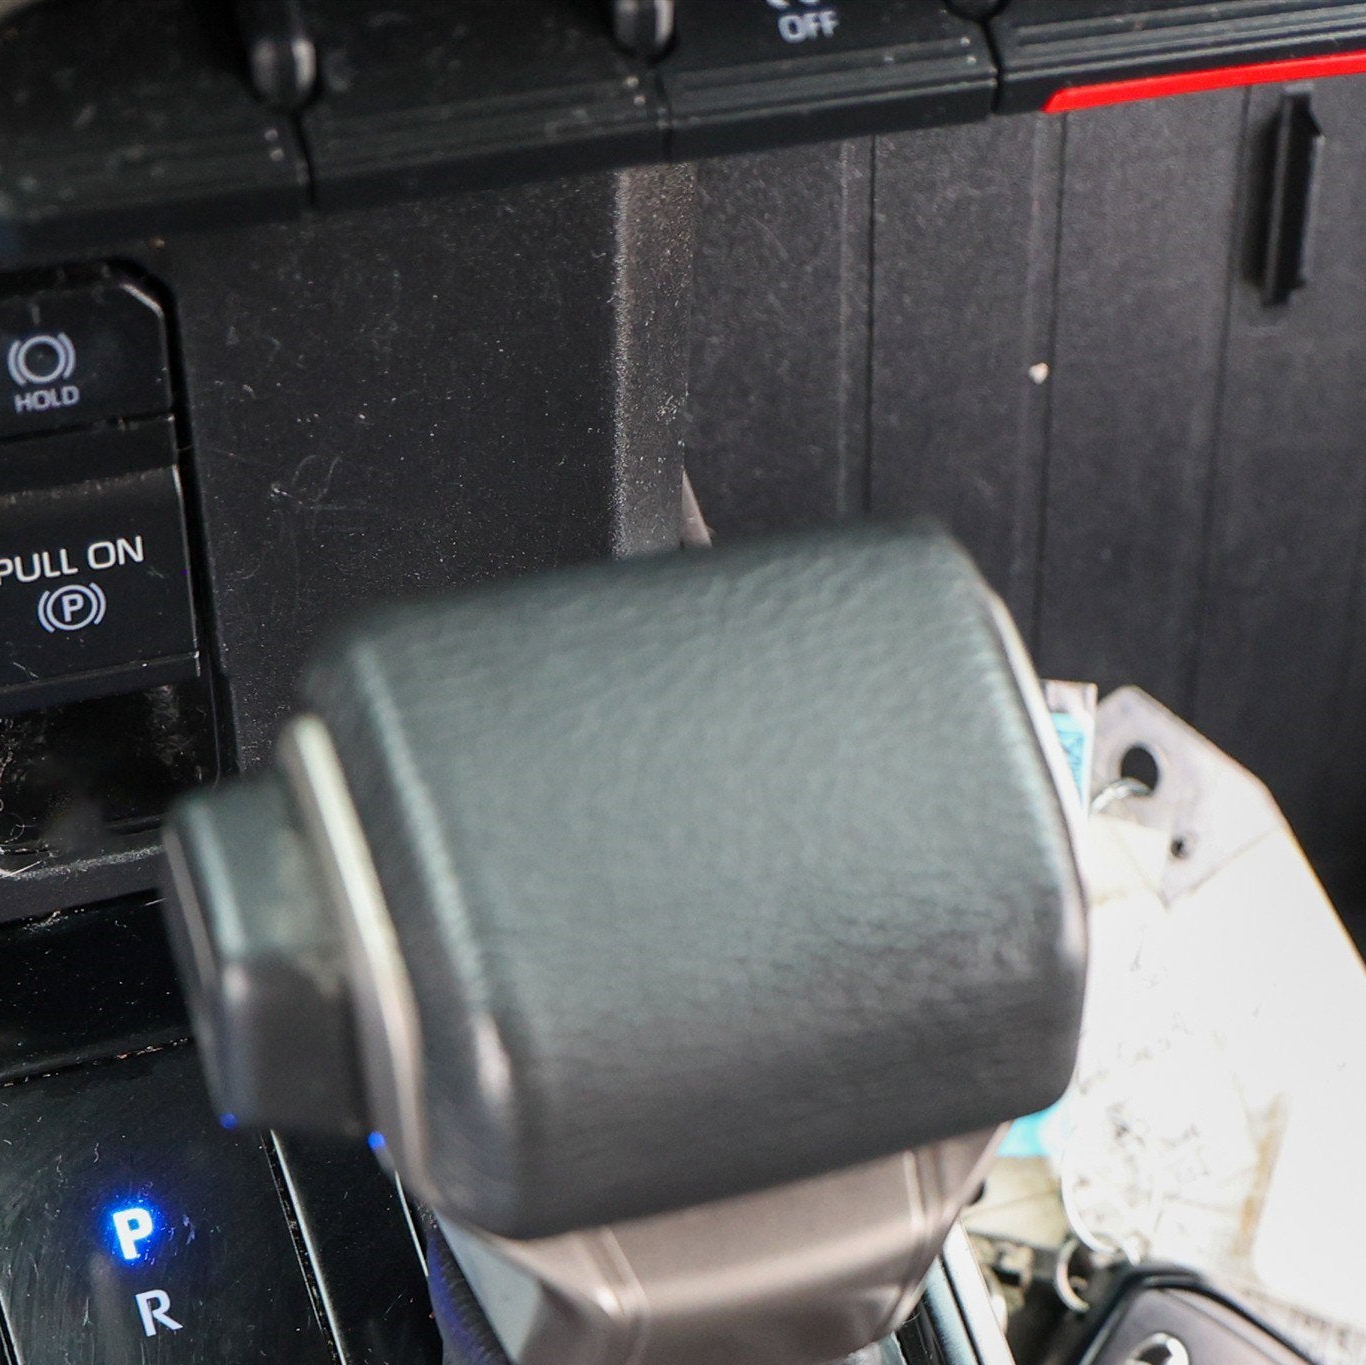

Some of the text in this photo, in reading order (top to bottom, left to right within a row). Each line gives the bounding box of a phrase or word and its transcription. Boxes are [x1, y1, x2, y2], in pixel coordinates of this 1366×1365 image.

[779, 10, 837, 43] OFF
[14, 386, 80, 414] HOLD
[87, 536, 144, 570] ON
[62, 594, 84, 622] P
[113, 1207, 154, 1260] P
[135, 1289, 183, 1336] R
